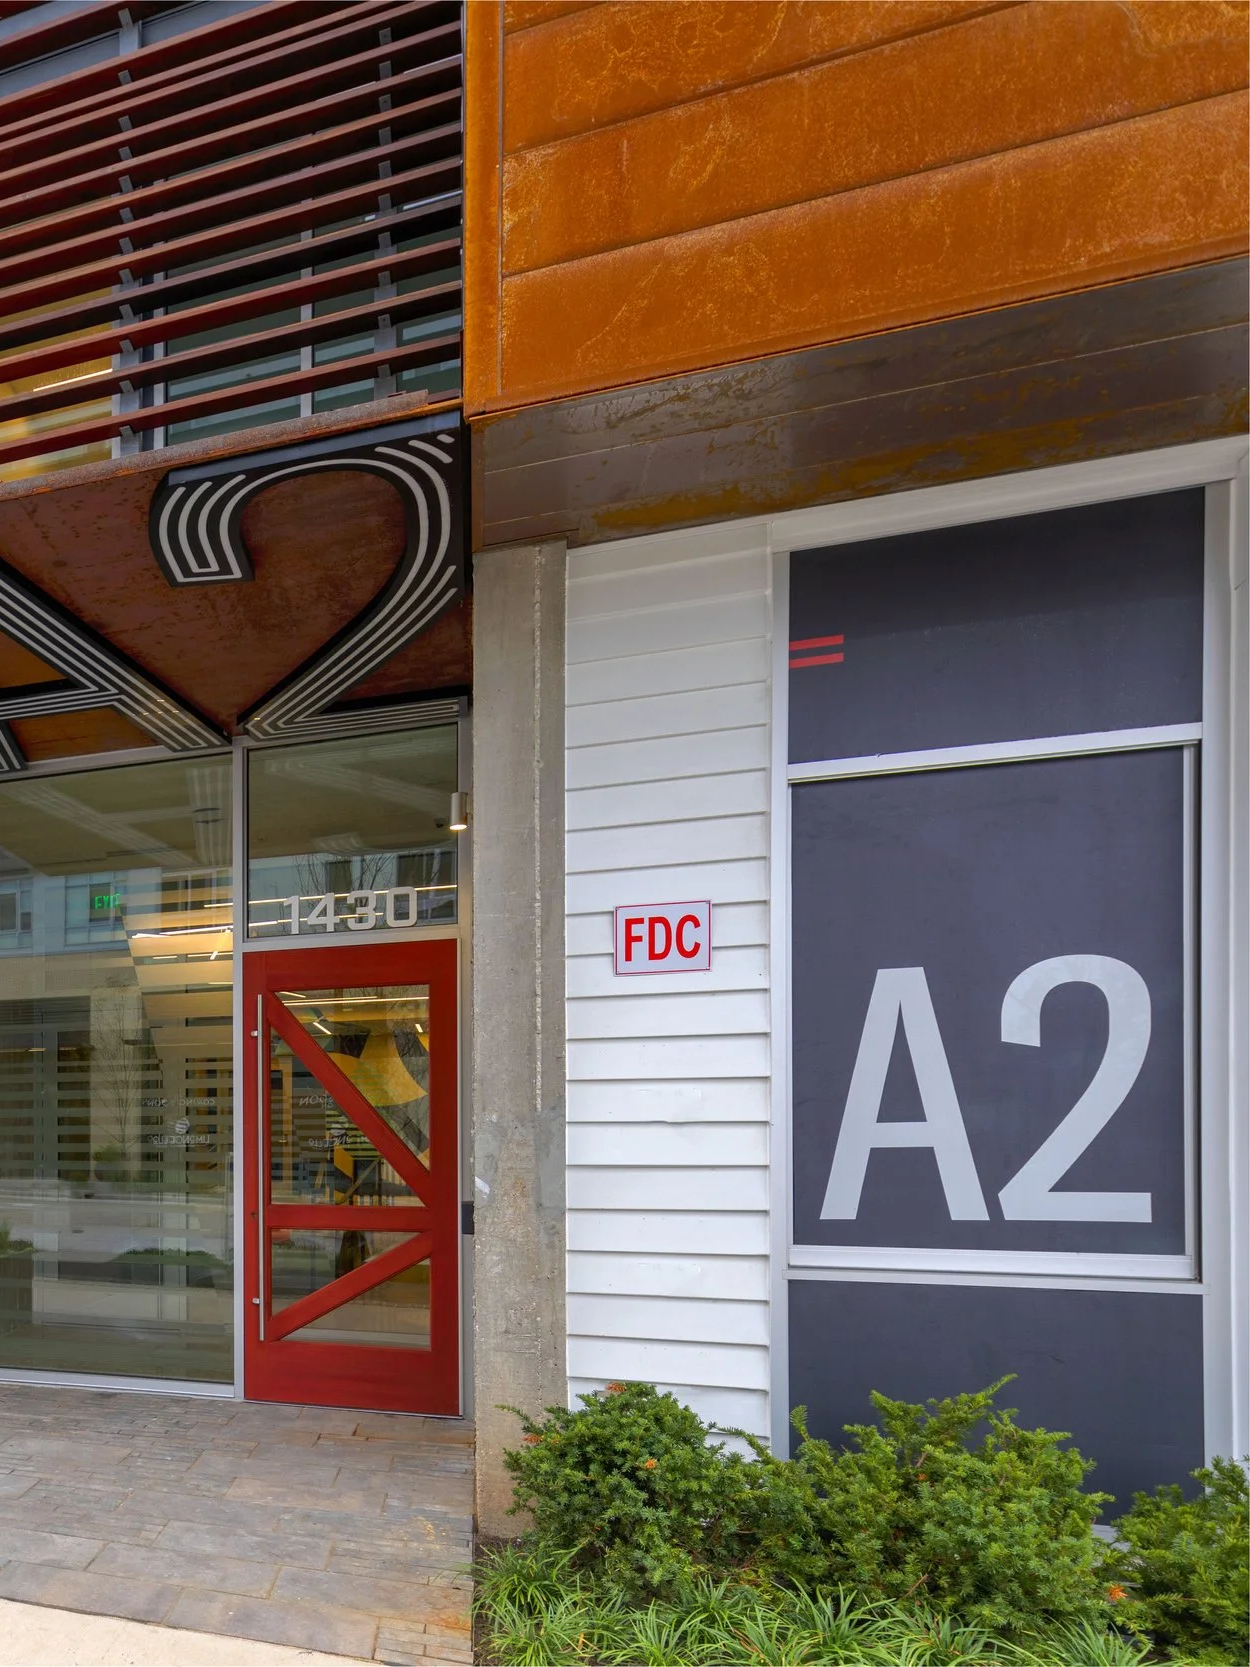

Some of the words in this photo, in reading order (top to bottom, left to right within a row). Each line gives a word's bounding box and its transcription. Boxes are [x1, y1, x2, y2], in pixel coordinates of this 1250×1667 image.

[283, 886, 418, 934] 1430
[624, 914, 701, 961] FDC
[819, 954, 1152, 1222] A2
